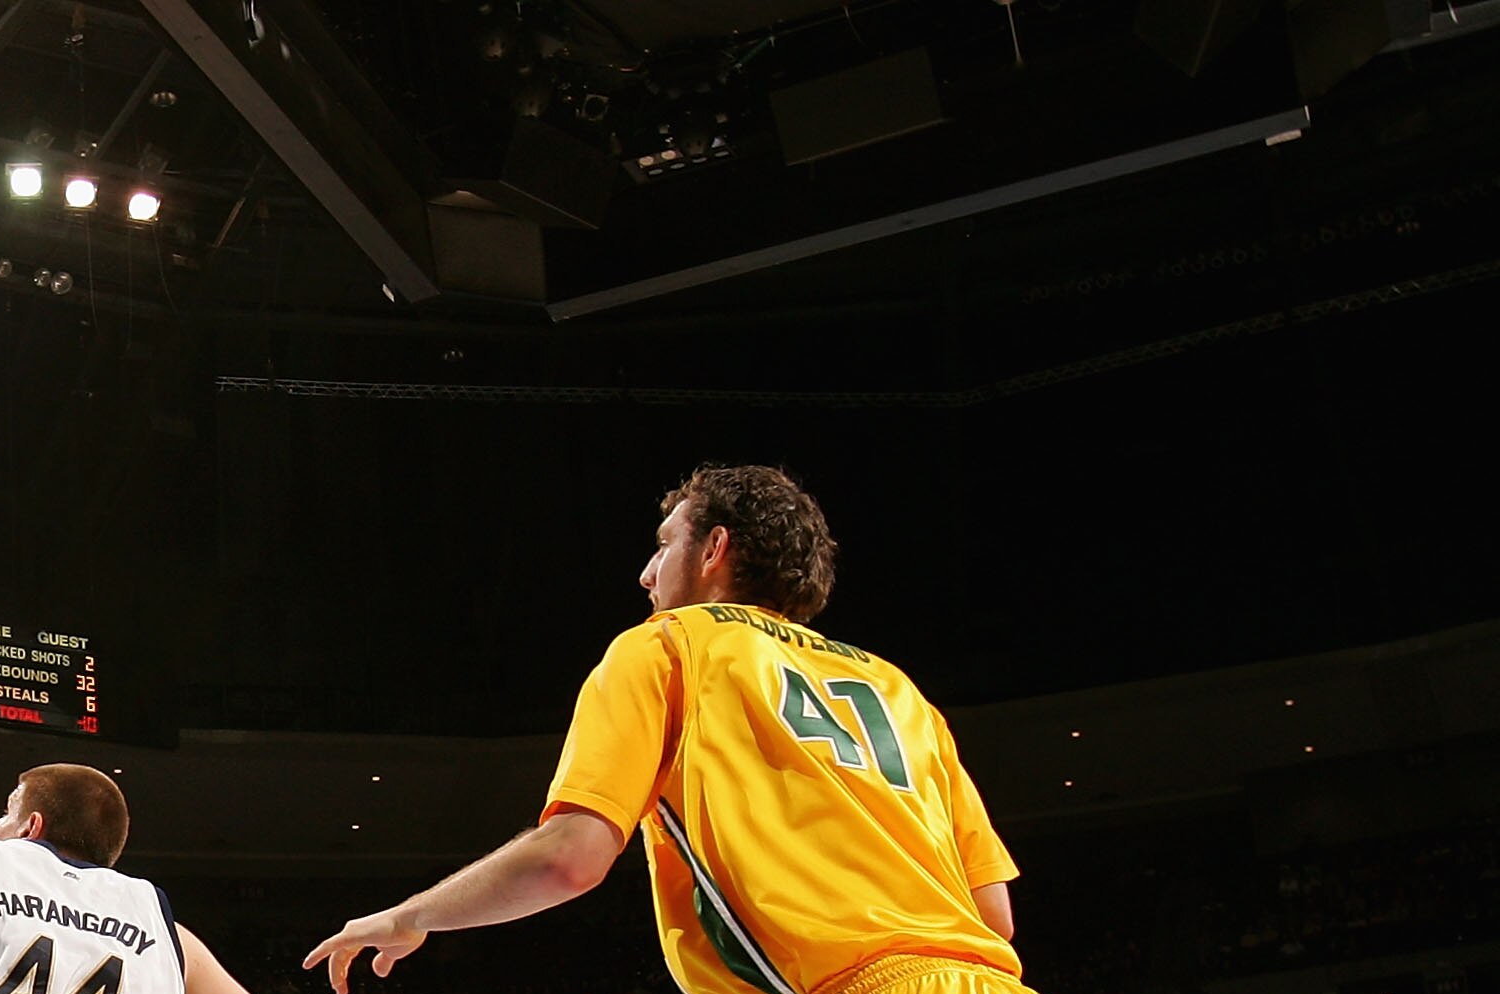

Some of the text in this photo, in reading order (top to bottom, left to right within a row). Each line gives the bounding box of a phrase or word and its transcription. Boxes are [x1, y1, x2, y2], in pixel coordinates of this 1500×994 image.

[37, 631, 89, 649] GUEST
[31, 650, 71, 666] SHOTS
[85, 656, 95, 671] 2
[76, 675, 96, 692] 32
[86, 696, 96, 712] 6
[778, 663, 913, 792] 41
